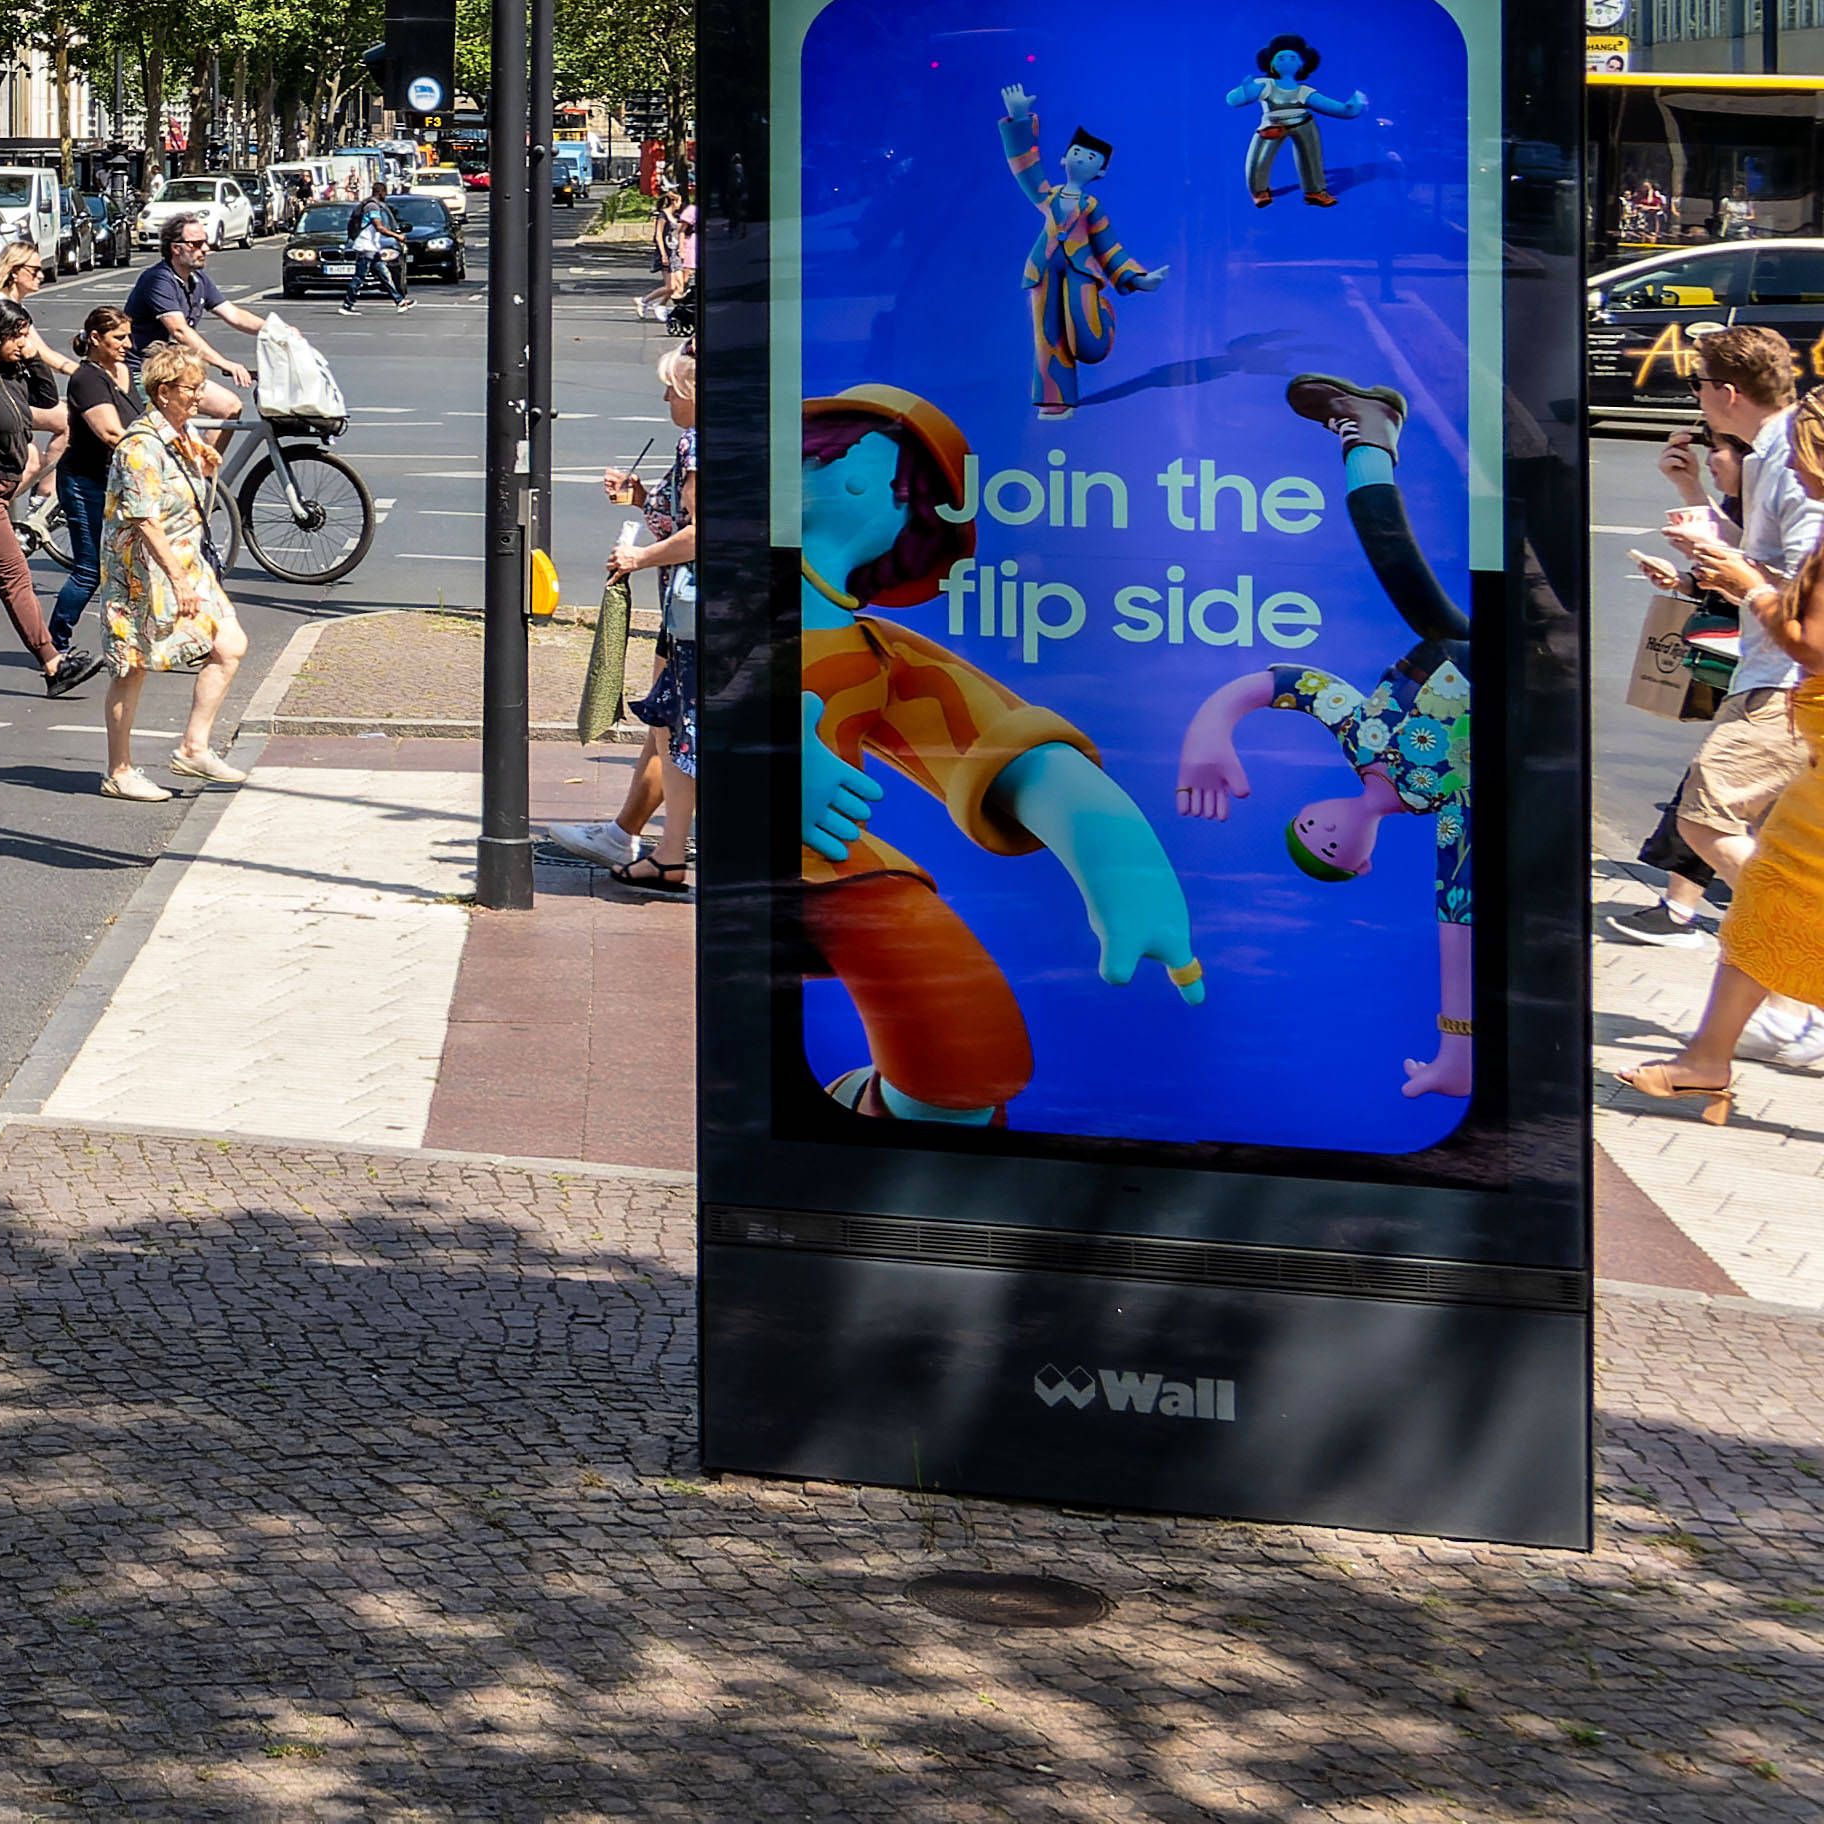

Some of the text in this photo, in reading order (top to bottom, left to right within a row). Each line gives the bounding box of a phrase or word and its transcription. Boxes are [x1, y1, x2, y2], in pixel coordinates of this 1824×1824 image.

[1587, 43, 1619, 52] HANGE
[424, 117, 442, 128] F3
[934, 449, 1326, 535] Join the
[938, 557, 1323, 664] flip side
[1098, 1368, 1236, 1422] Wall
